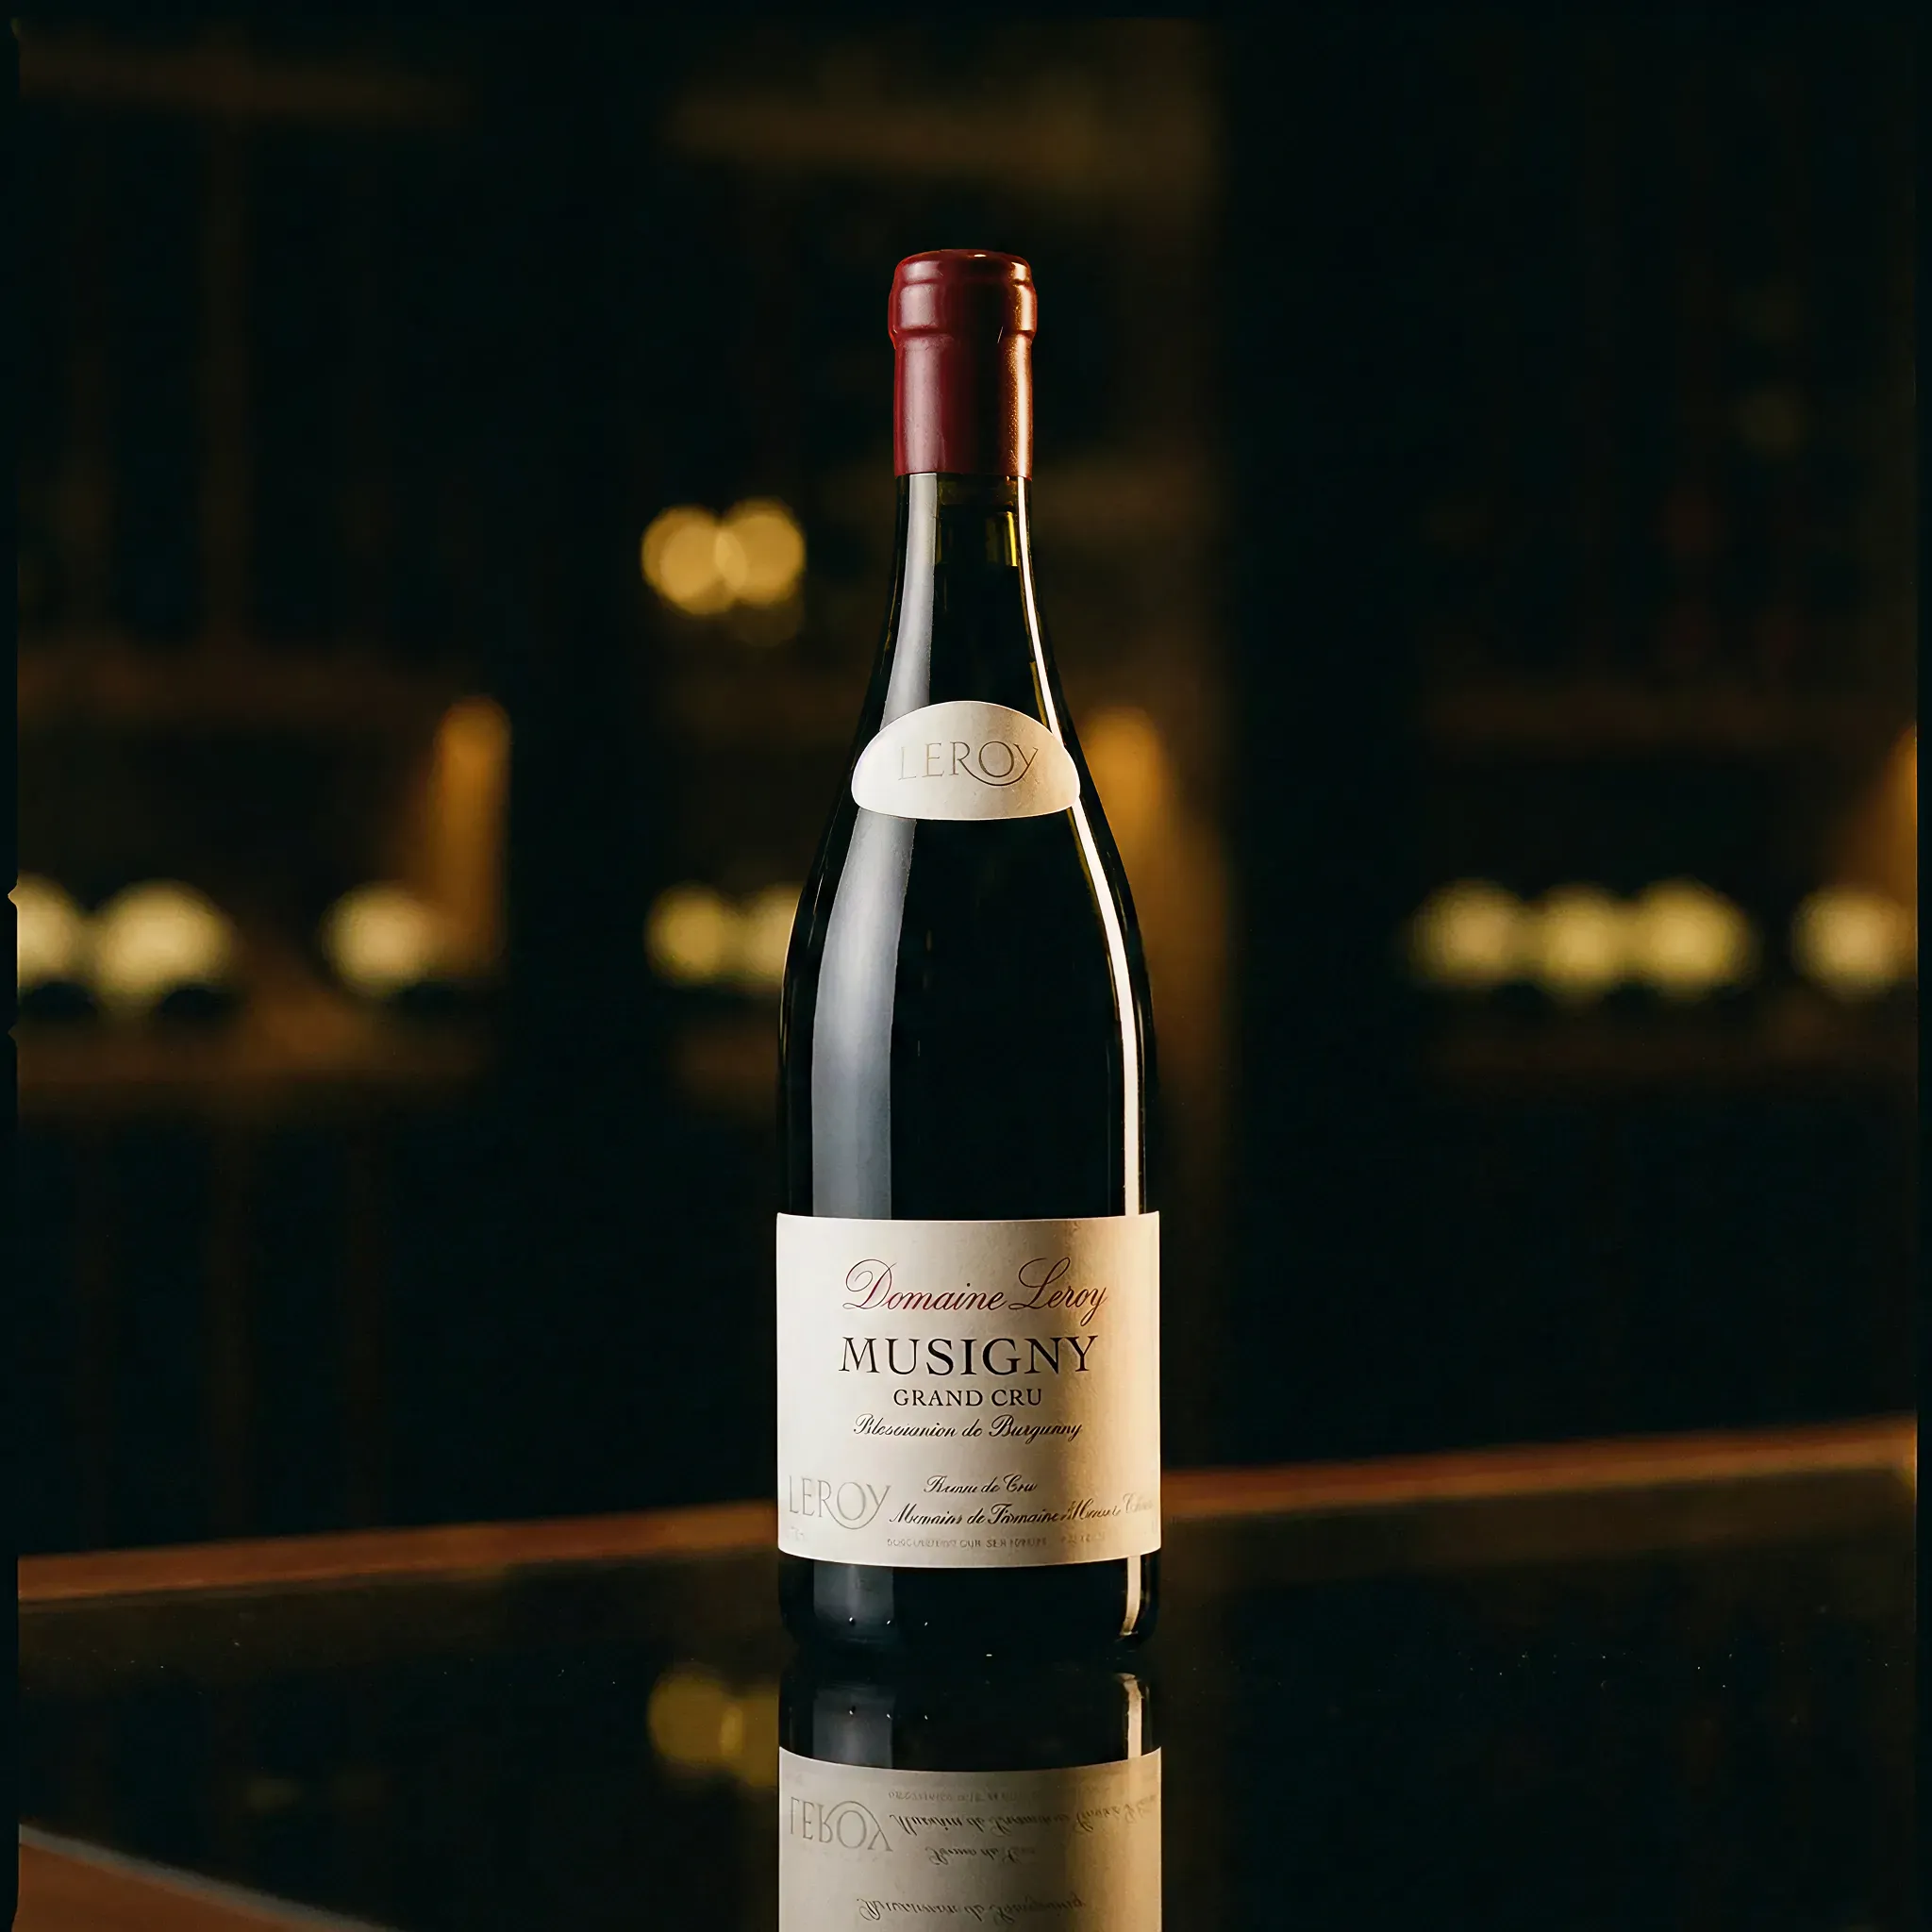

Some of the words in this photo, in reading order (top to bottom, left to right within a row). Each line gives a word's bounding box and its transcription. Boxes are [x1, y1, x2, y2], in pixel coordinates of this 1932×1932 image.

[898, 741, 1039, 786] LEROY
[842, 1258, 1006, 1310] Domaine
[1008, 1257, 1109, 1326] Leroy
[838, 1335, 1098, 1376] MUSIGNY
[892, 1389, 984, 1407] GRAND
[991, 1388, 1043, 1407] CRU
[788, 1474, 891, 1530] LEROY
